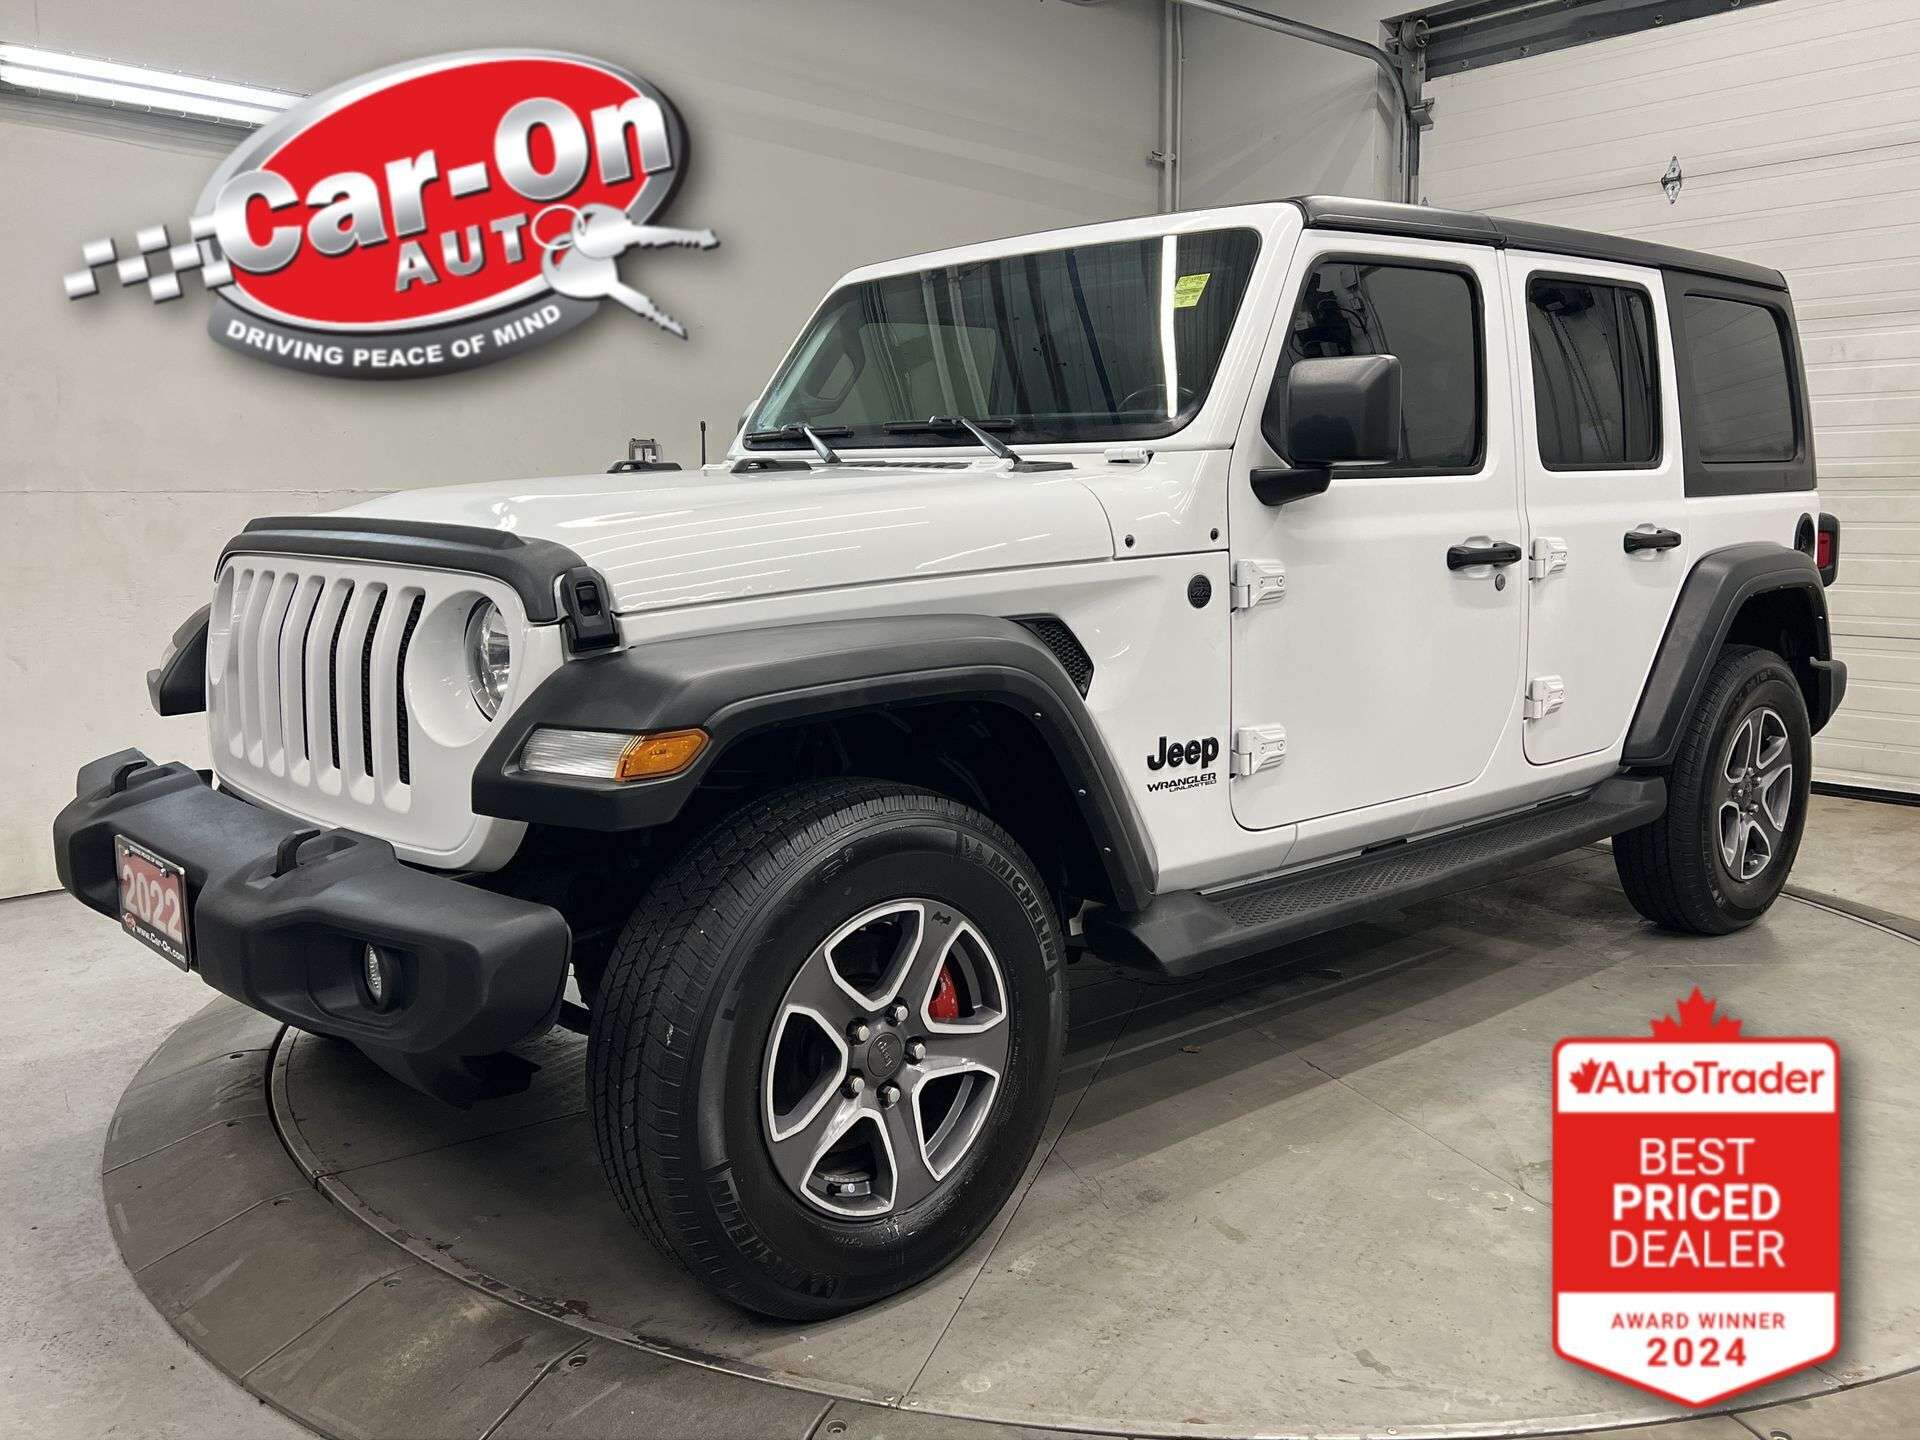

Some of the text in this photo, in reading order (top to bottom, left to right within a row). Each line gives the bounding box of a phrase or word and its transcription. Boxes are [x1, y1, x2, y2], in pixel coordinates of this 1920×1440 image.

[1146, 735, 1220, 771] Jeep
[1146, 772, 1217, 793] WRANGLER
[1168, 779, 1217, 793] UNLIMITED
[122, 863, 184, 945] 2022
[987, 850, 1058, 967] MICHELIN
